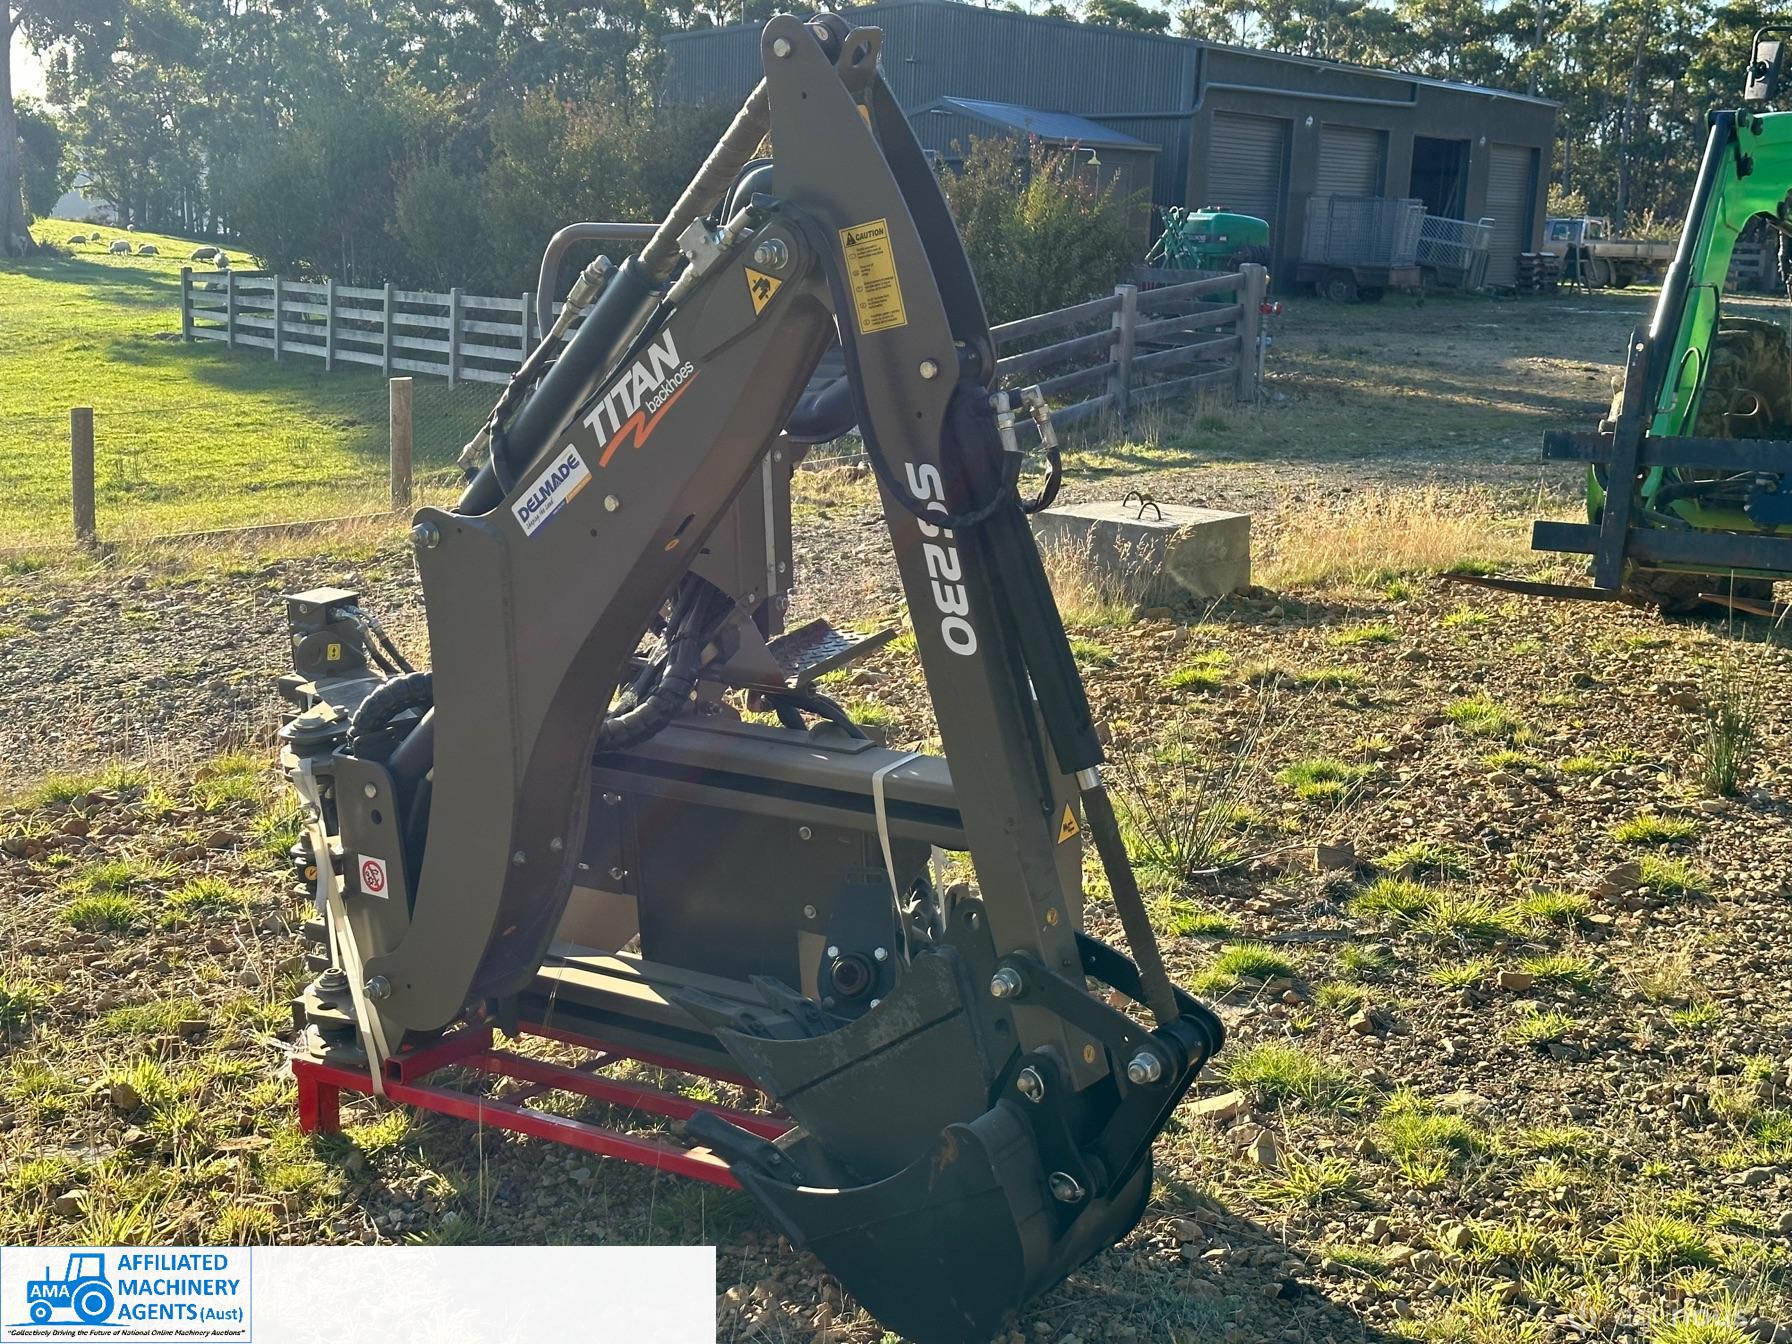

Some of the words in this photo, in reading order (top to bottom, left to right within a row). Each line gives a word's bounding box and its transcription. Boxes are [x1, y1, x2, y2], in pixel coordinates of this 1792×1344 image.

[855, 227, 884, 241] CAUTION
[583, 328, 680, 447] TITAN
[645, 361, 694, 414] backhoes
[518, 453, 580, 523] DELMADE
